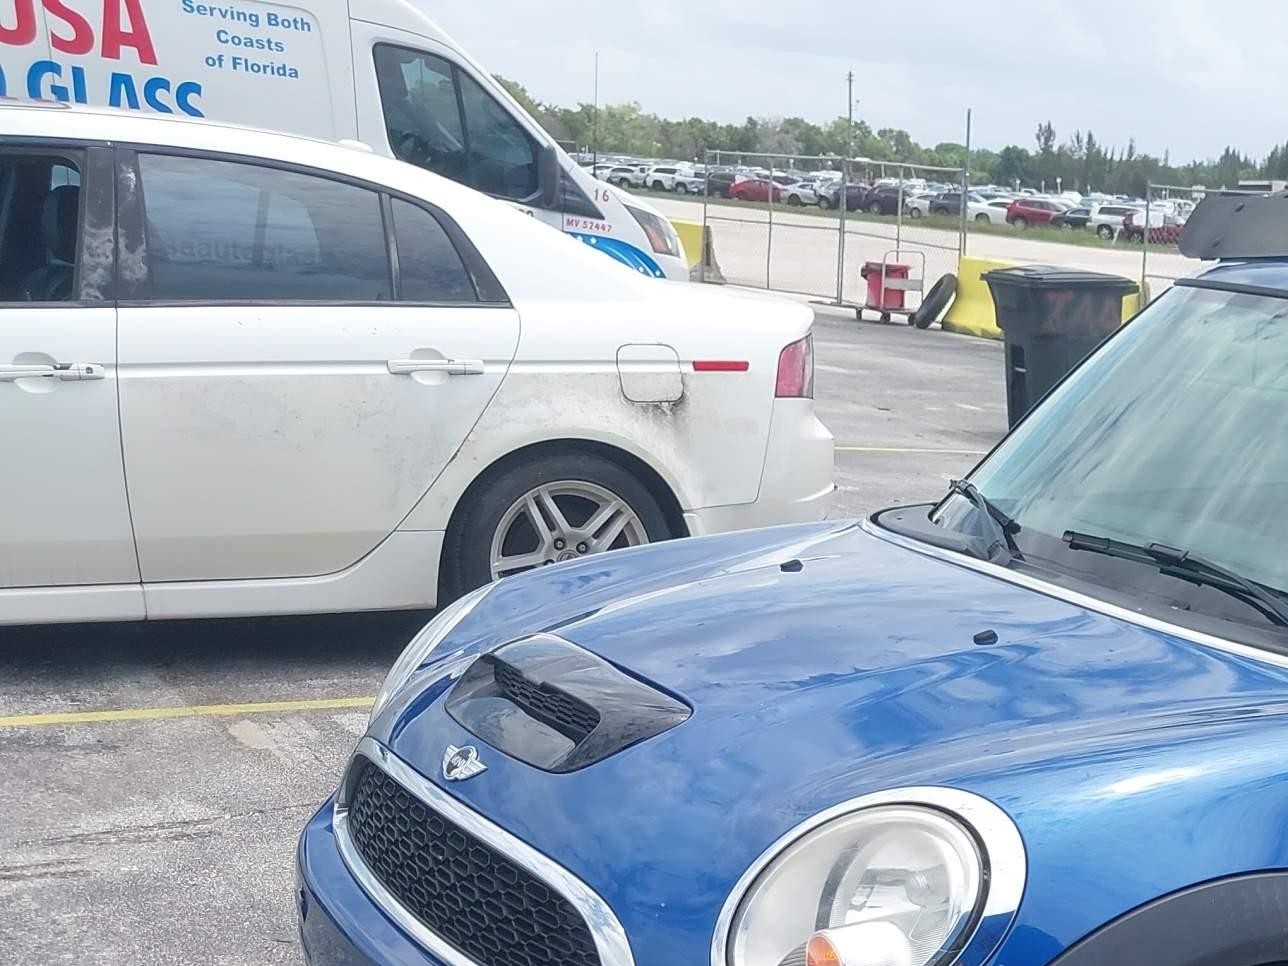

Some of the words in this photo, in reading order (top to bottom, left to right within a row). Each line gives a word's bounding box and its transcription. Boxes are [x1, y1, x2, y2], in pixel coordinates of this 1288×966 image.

[182, 0, 259, 27] Serving
[267, 13, 312, 33] Both
[216, 29, 285, 53] Coasts
[204, 54, 225, 69] of
[231, 56, 300, 80] Florida
[594, 188, 610, 202] 16
[565, 217, 581, 228] MV
